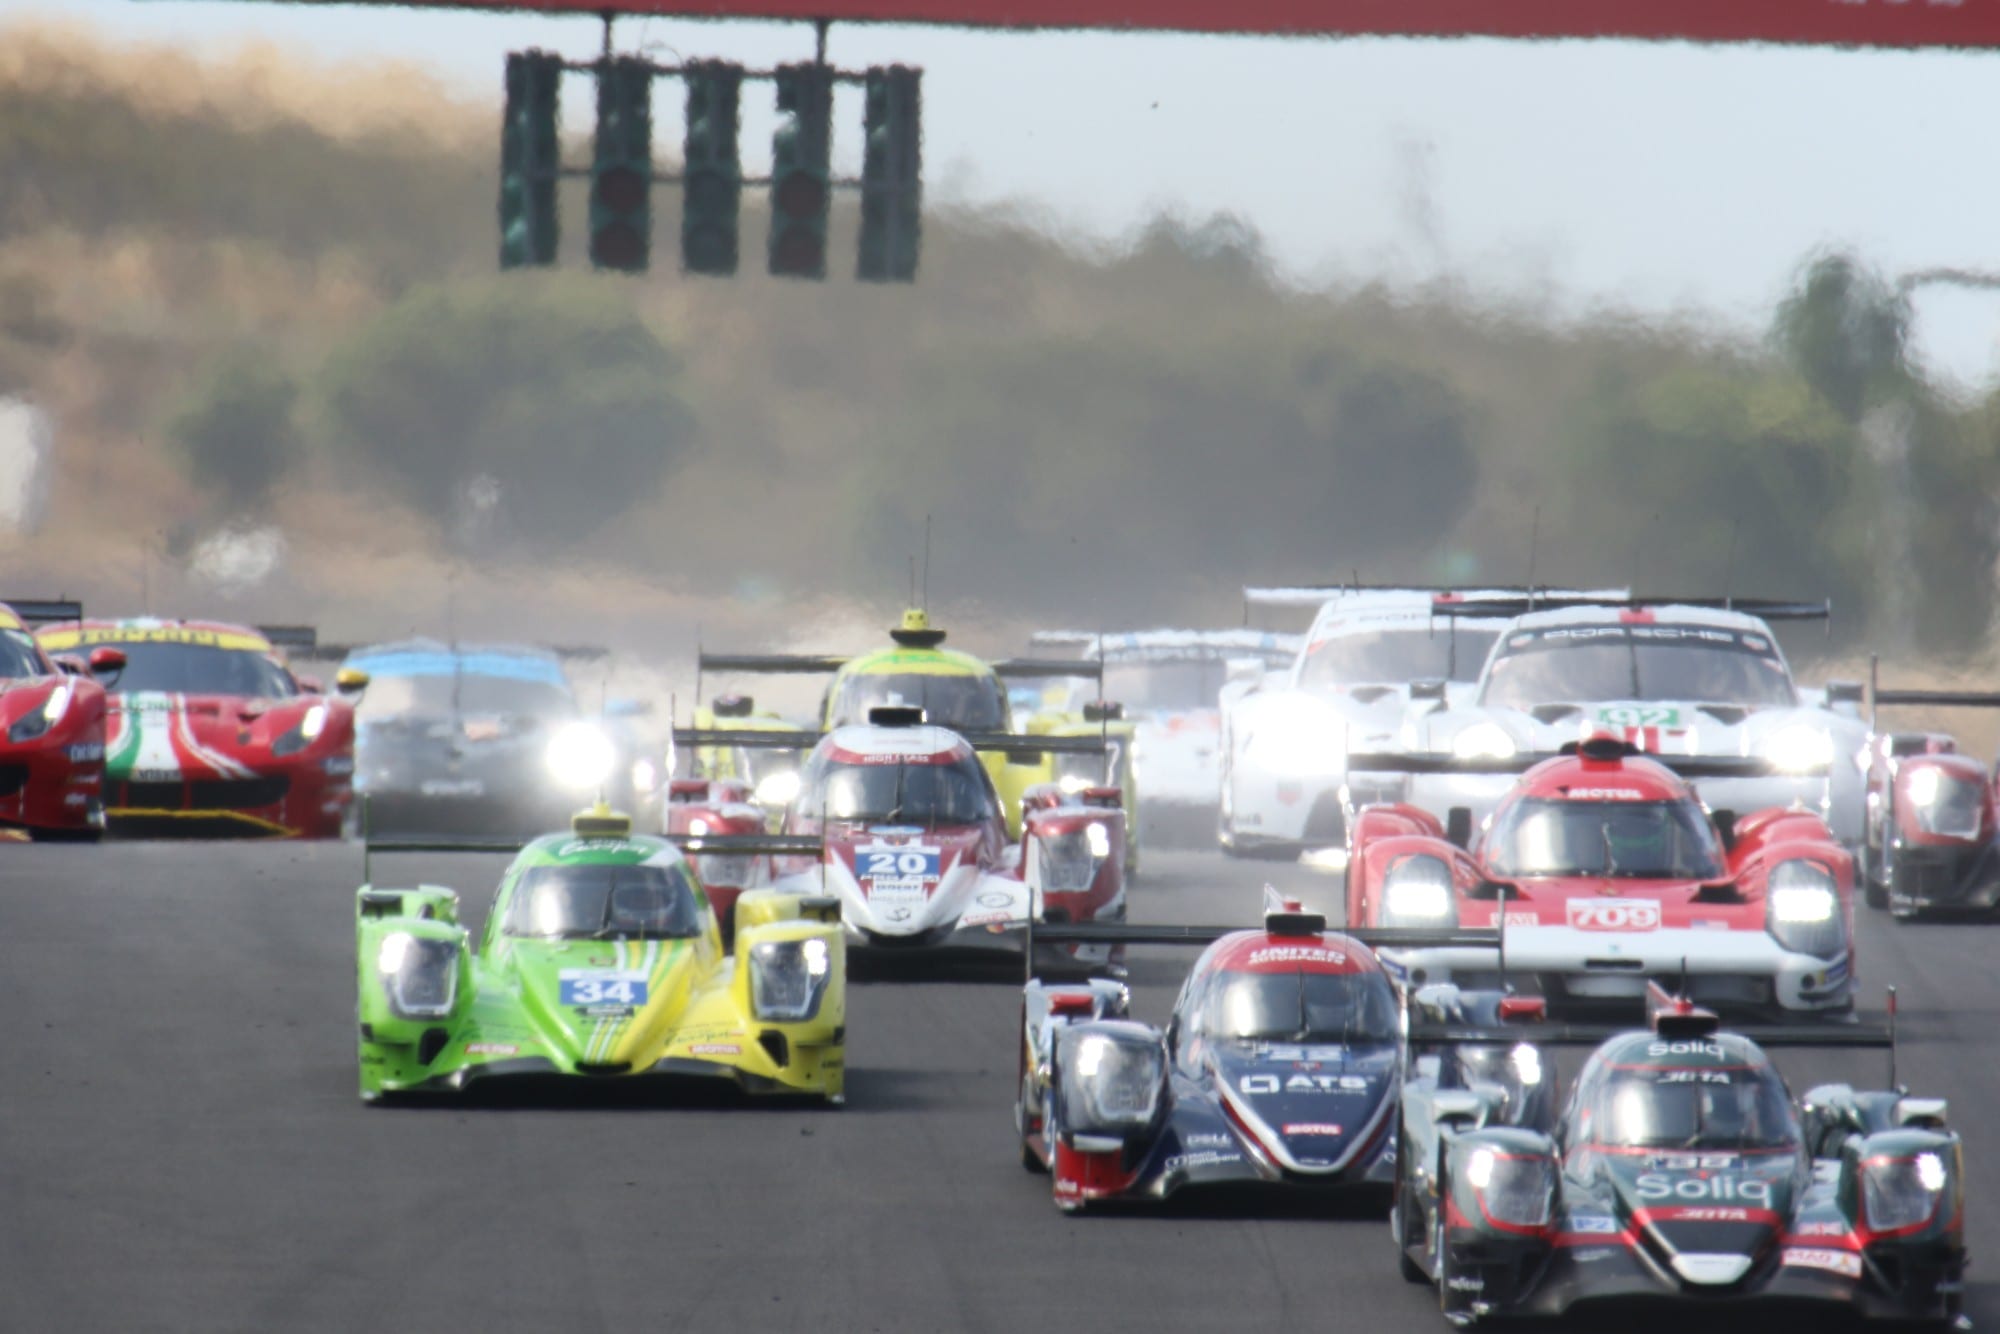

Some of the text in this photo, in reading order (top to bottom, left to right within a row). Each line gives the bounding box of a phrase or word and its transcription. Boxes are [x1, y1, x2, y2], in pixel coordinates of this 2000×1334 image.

[1543, 626, 1734, 643] PORSCHE
[1607, 706, 1672, 726] 92
[1567, 788, 1644, 800] MOTUL
[868, 853, 927, 874] 20
[1571, 906, 1658, 928] 709
[1249, 946, 1346, 961] UNITED
[572, 979, 635, 1003] 34
[1284, 1122, 1342, 1135] MOTUL
[1635, 1173, 1773, 1210] Soliq
